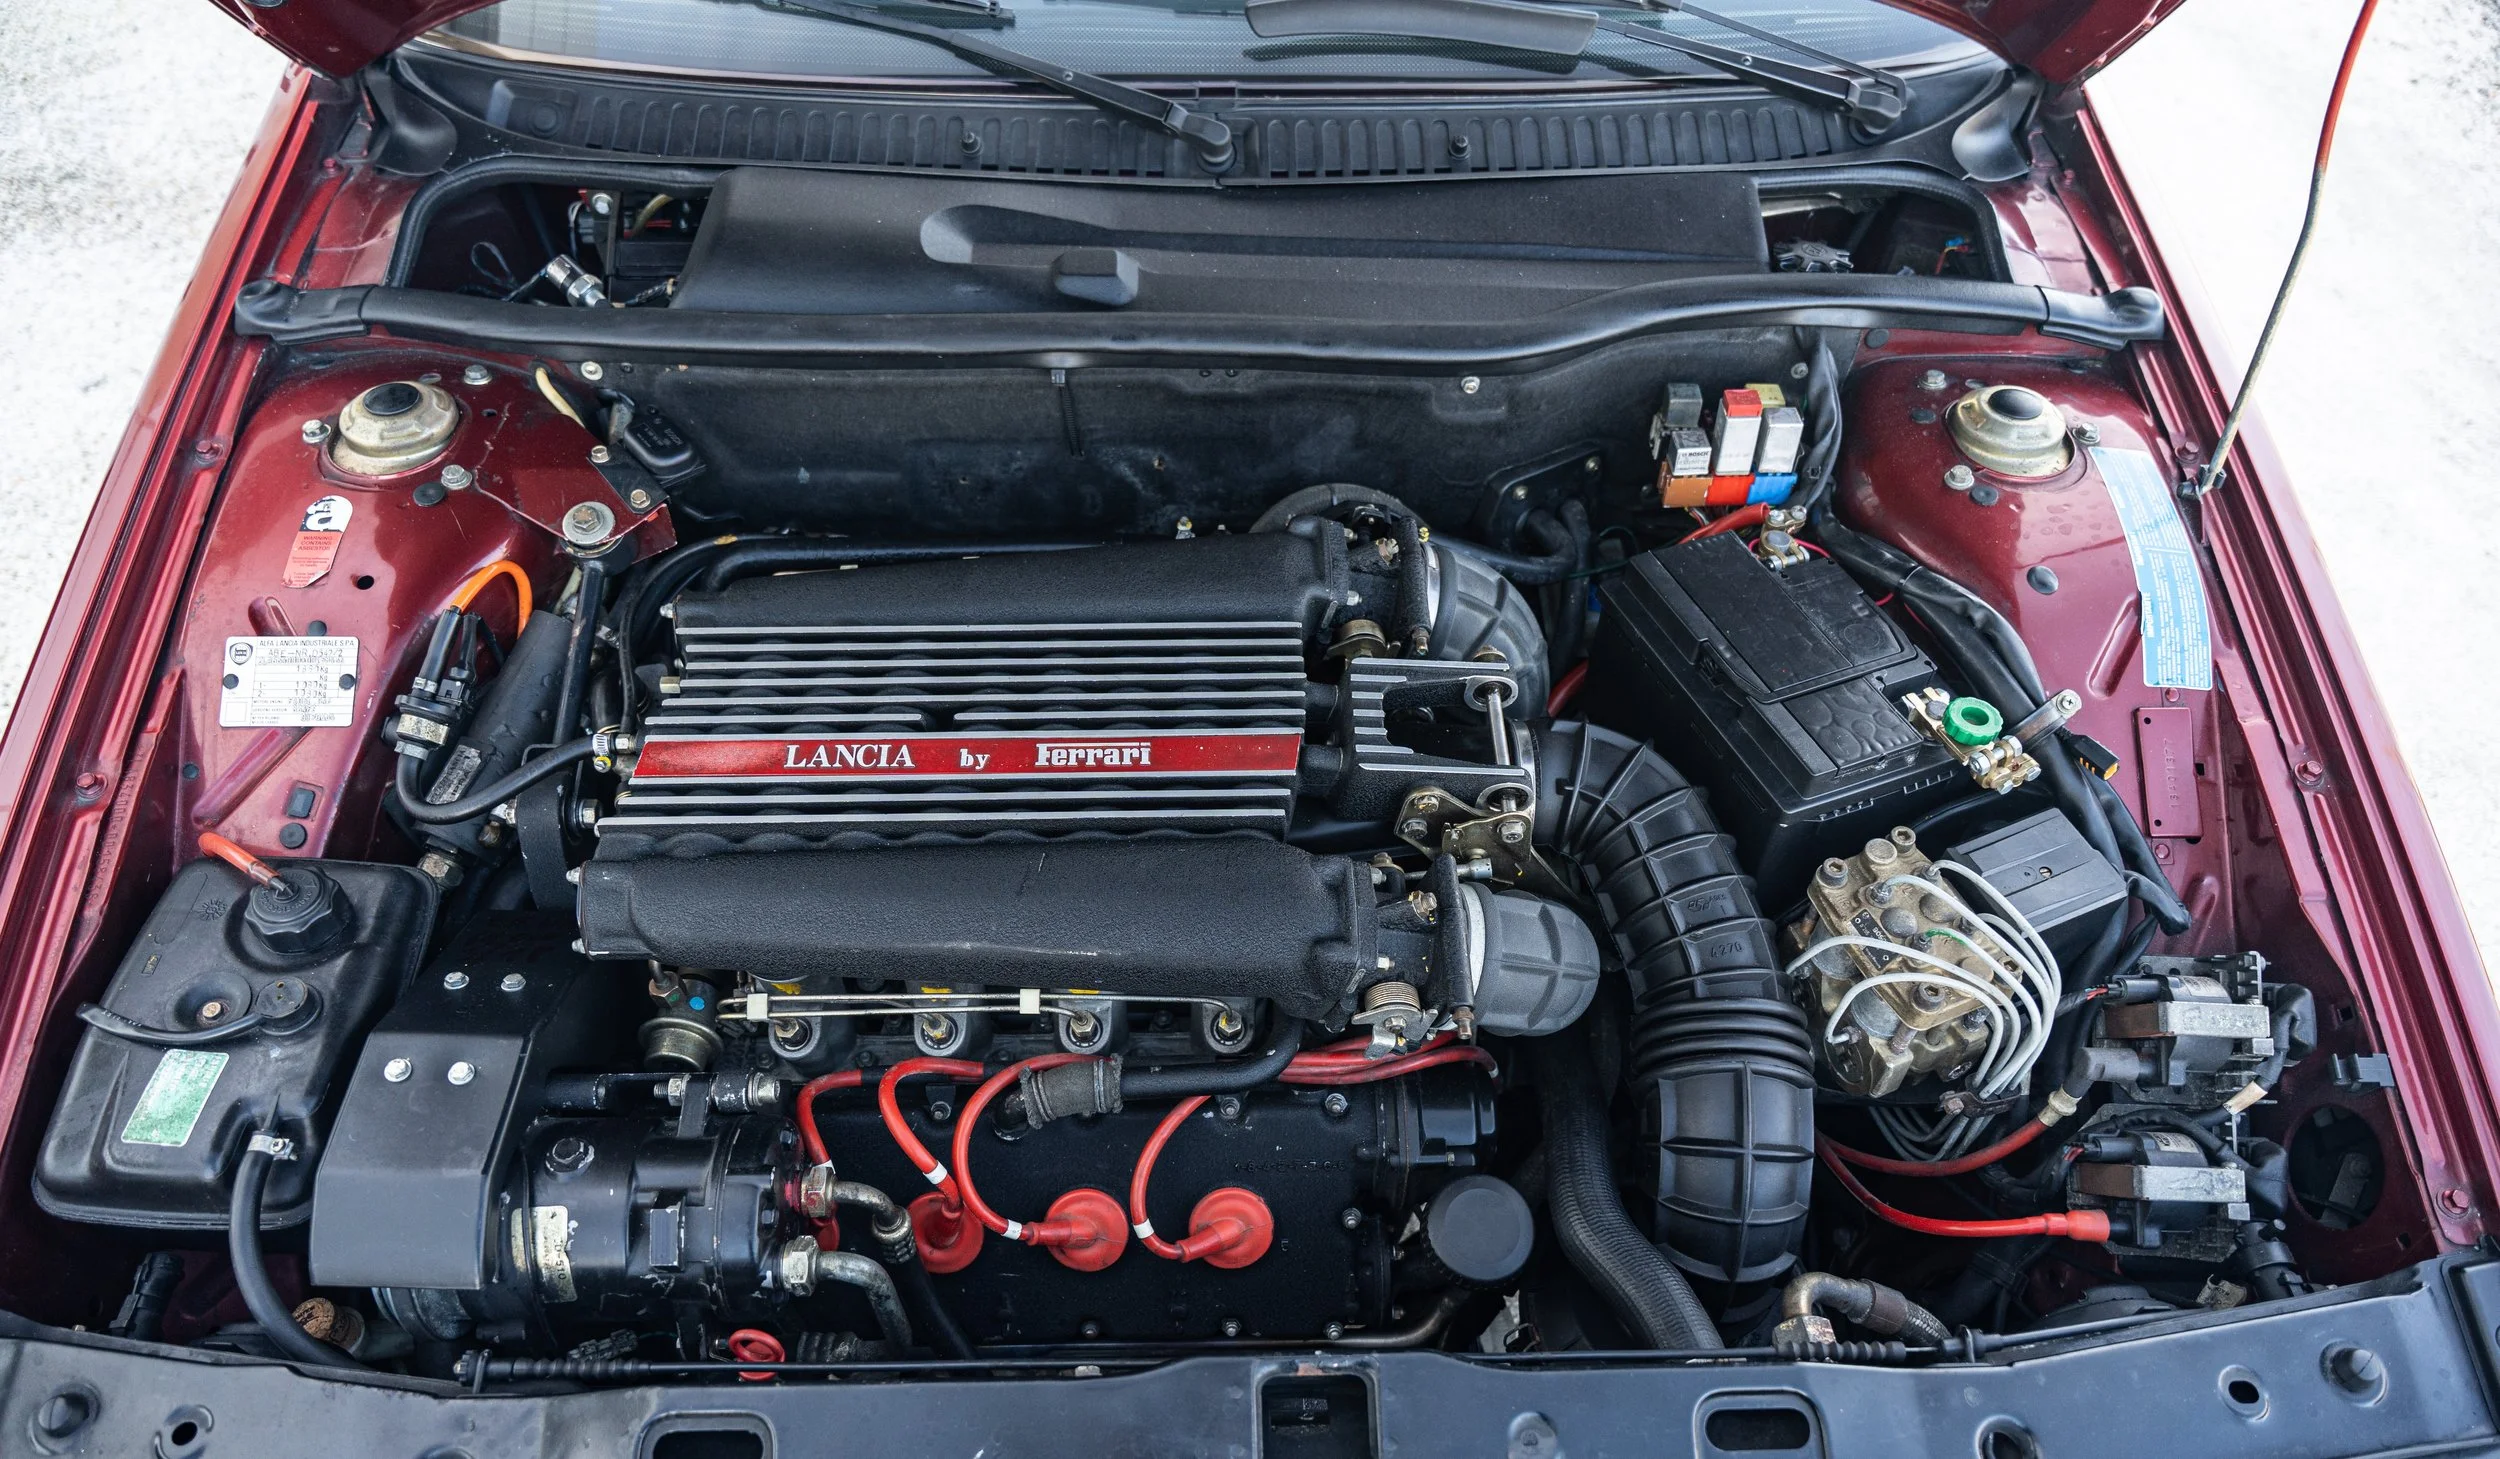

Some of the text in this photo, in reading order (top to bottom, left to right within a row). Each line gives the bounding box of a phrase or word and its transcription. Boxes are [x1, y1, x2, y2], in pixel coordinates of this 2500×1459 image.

[259, 639, 274, 647] ALFA
[275, 639, 298, 647] LANCIA
[299, 639, 338, 647] INDUSTRIALE
[783, 741, 1151, 770] LANCIA by Ferrari
